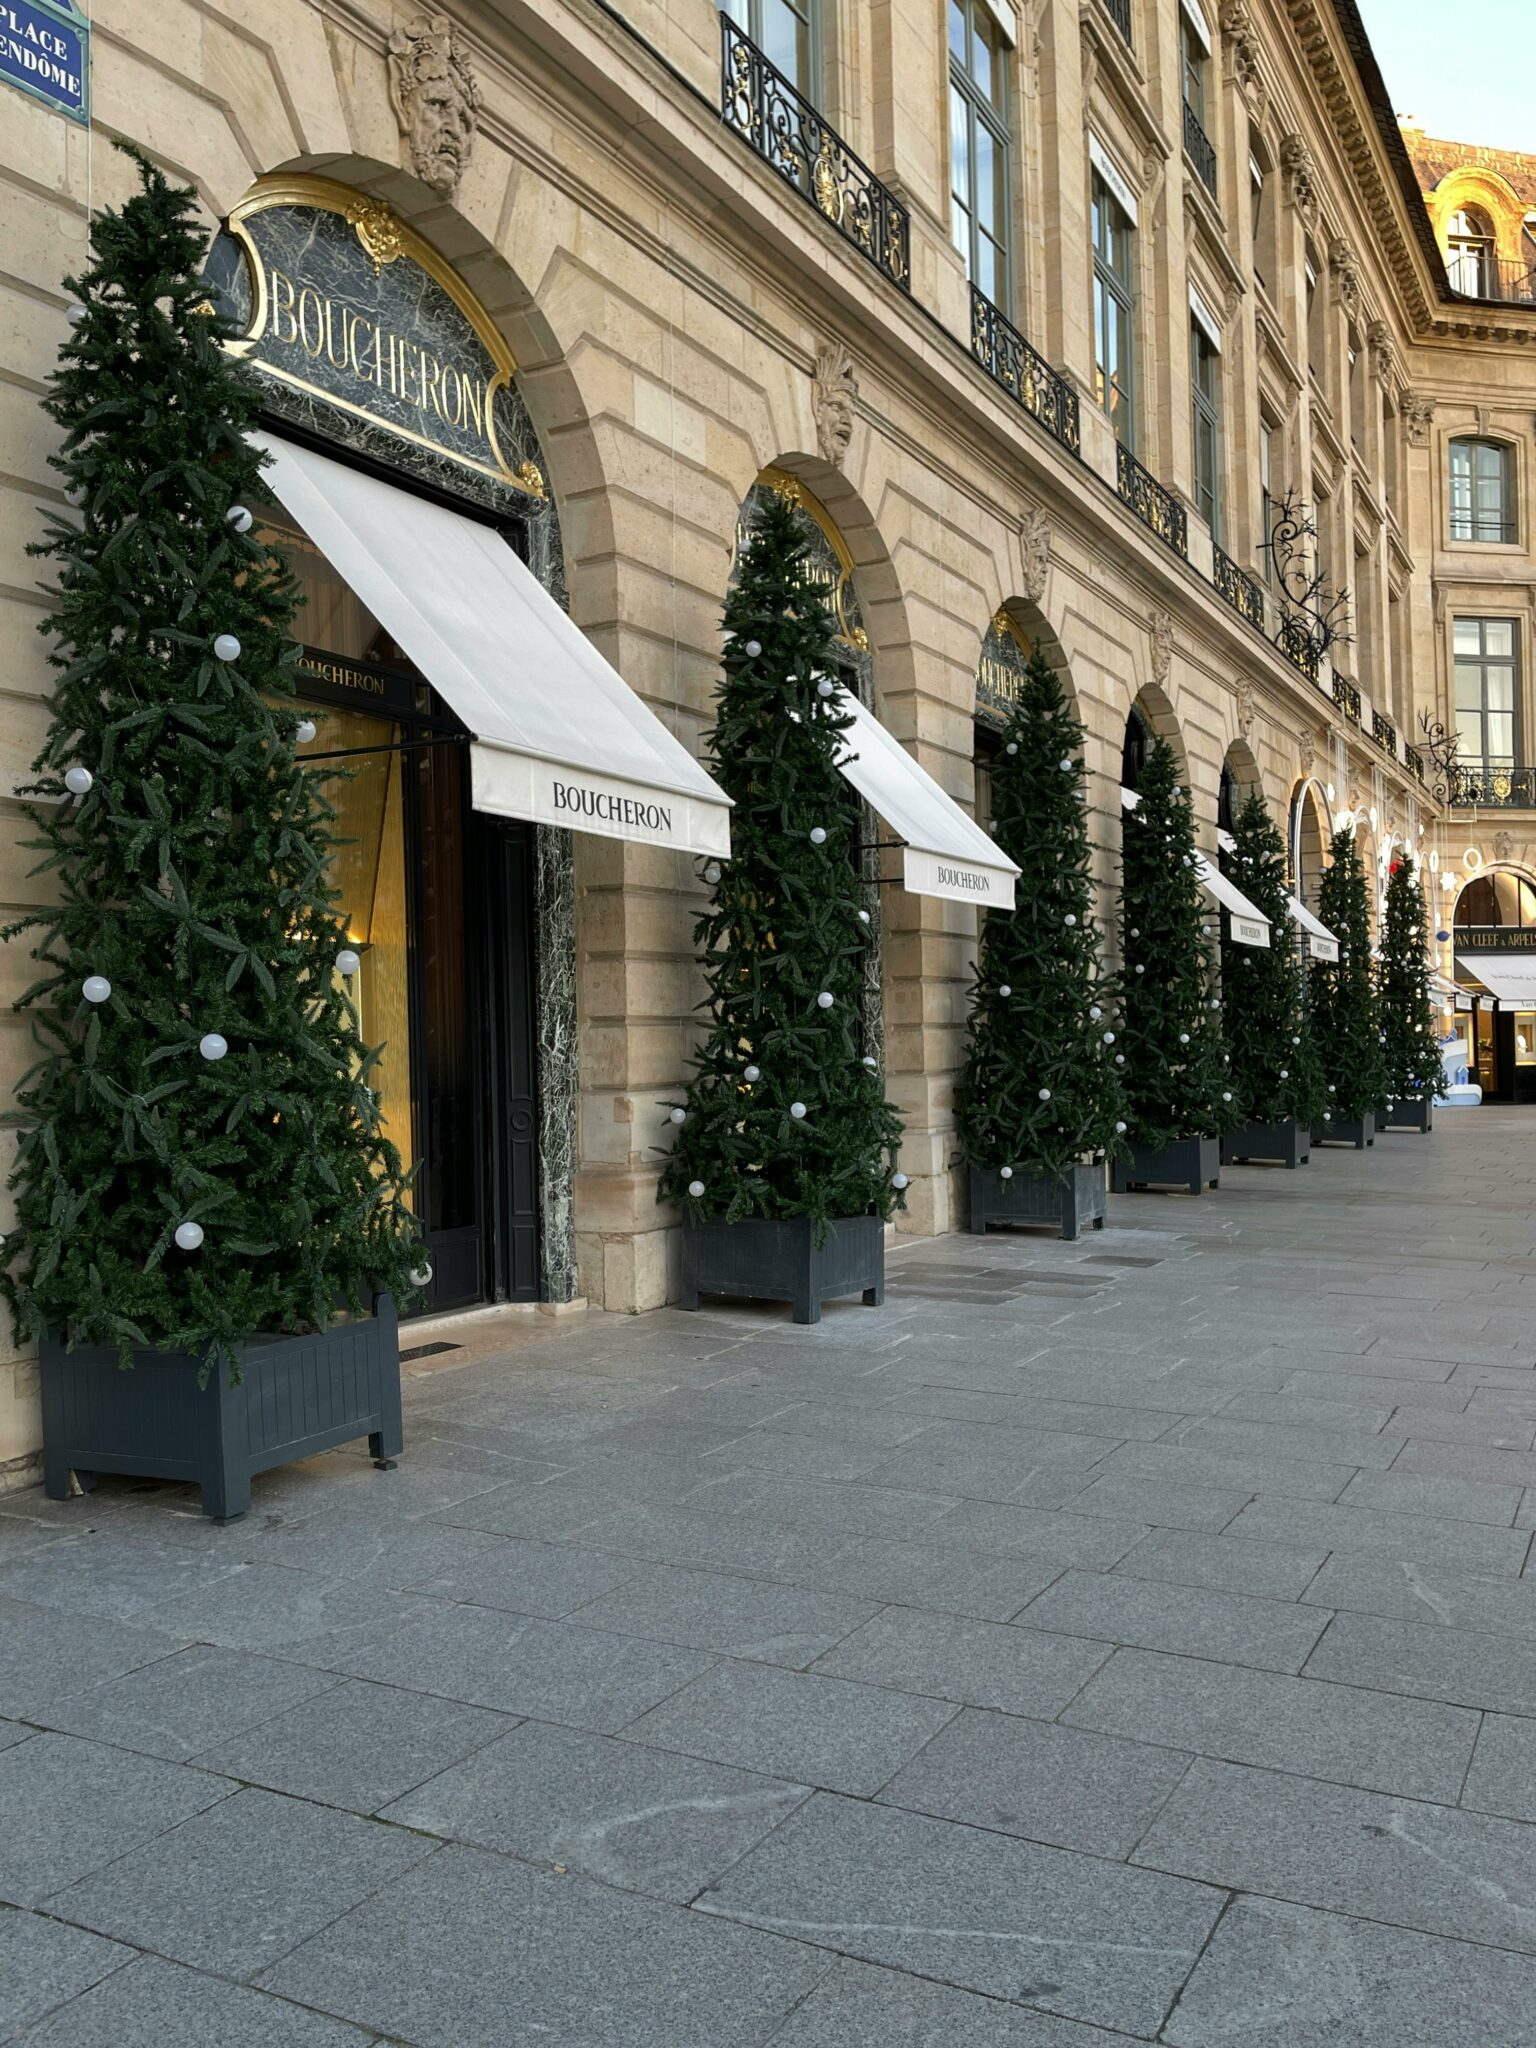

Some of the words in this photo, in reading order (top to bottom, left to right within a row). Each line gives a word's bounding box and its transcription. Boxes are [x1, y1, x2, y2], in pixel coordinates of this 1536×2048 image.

[271, 270, 482, 437] BOUCHERON
[294, 657, 384, 694] OUCHERON
[553, 782, 672, 832] BOUCHERON
[938, 866, 990, 891] BOUCHERON
[1472, 933, 1499, 946] CLEEF
[1508, 933, 1536, 946] ARPEL
